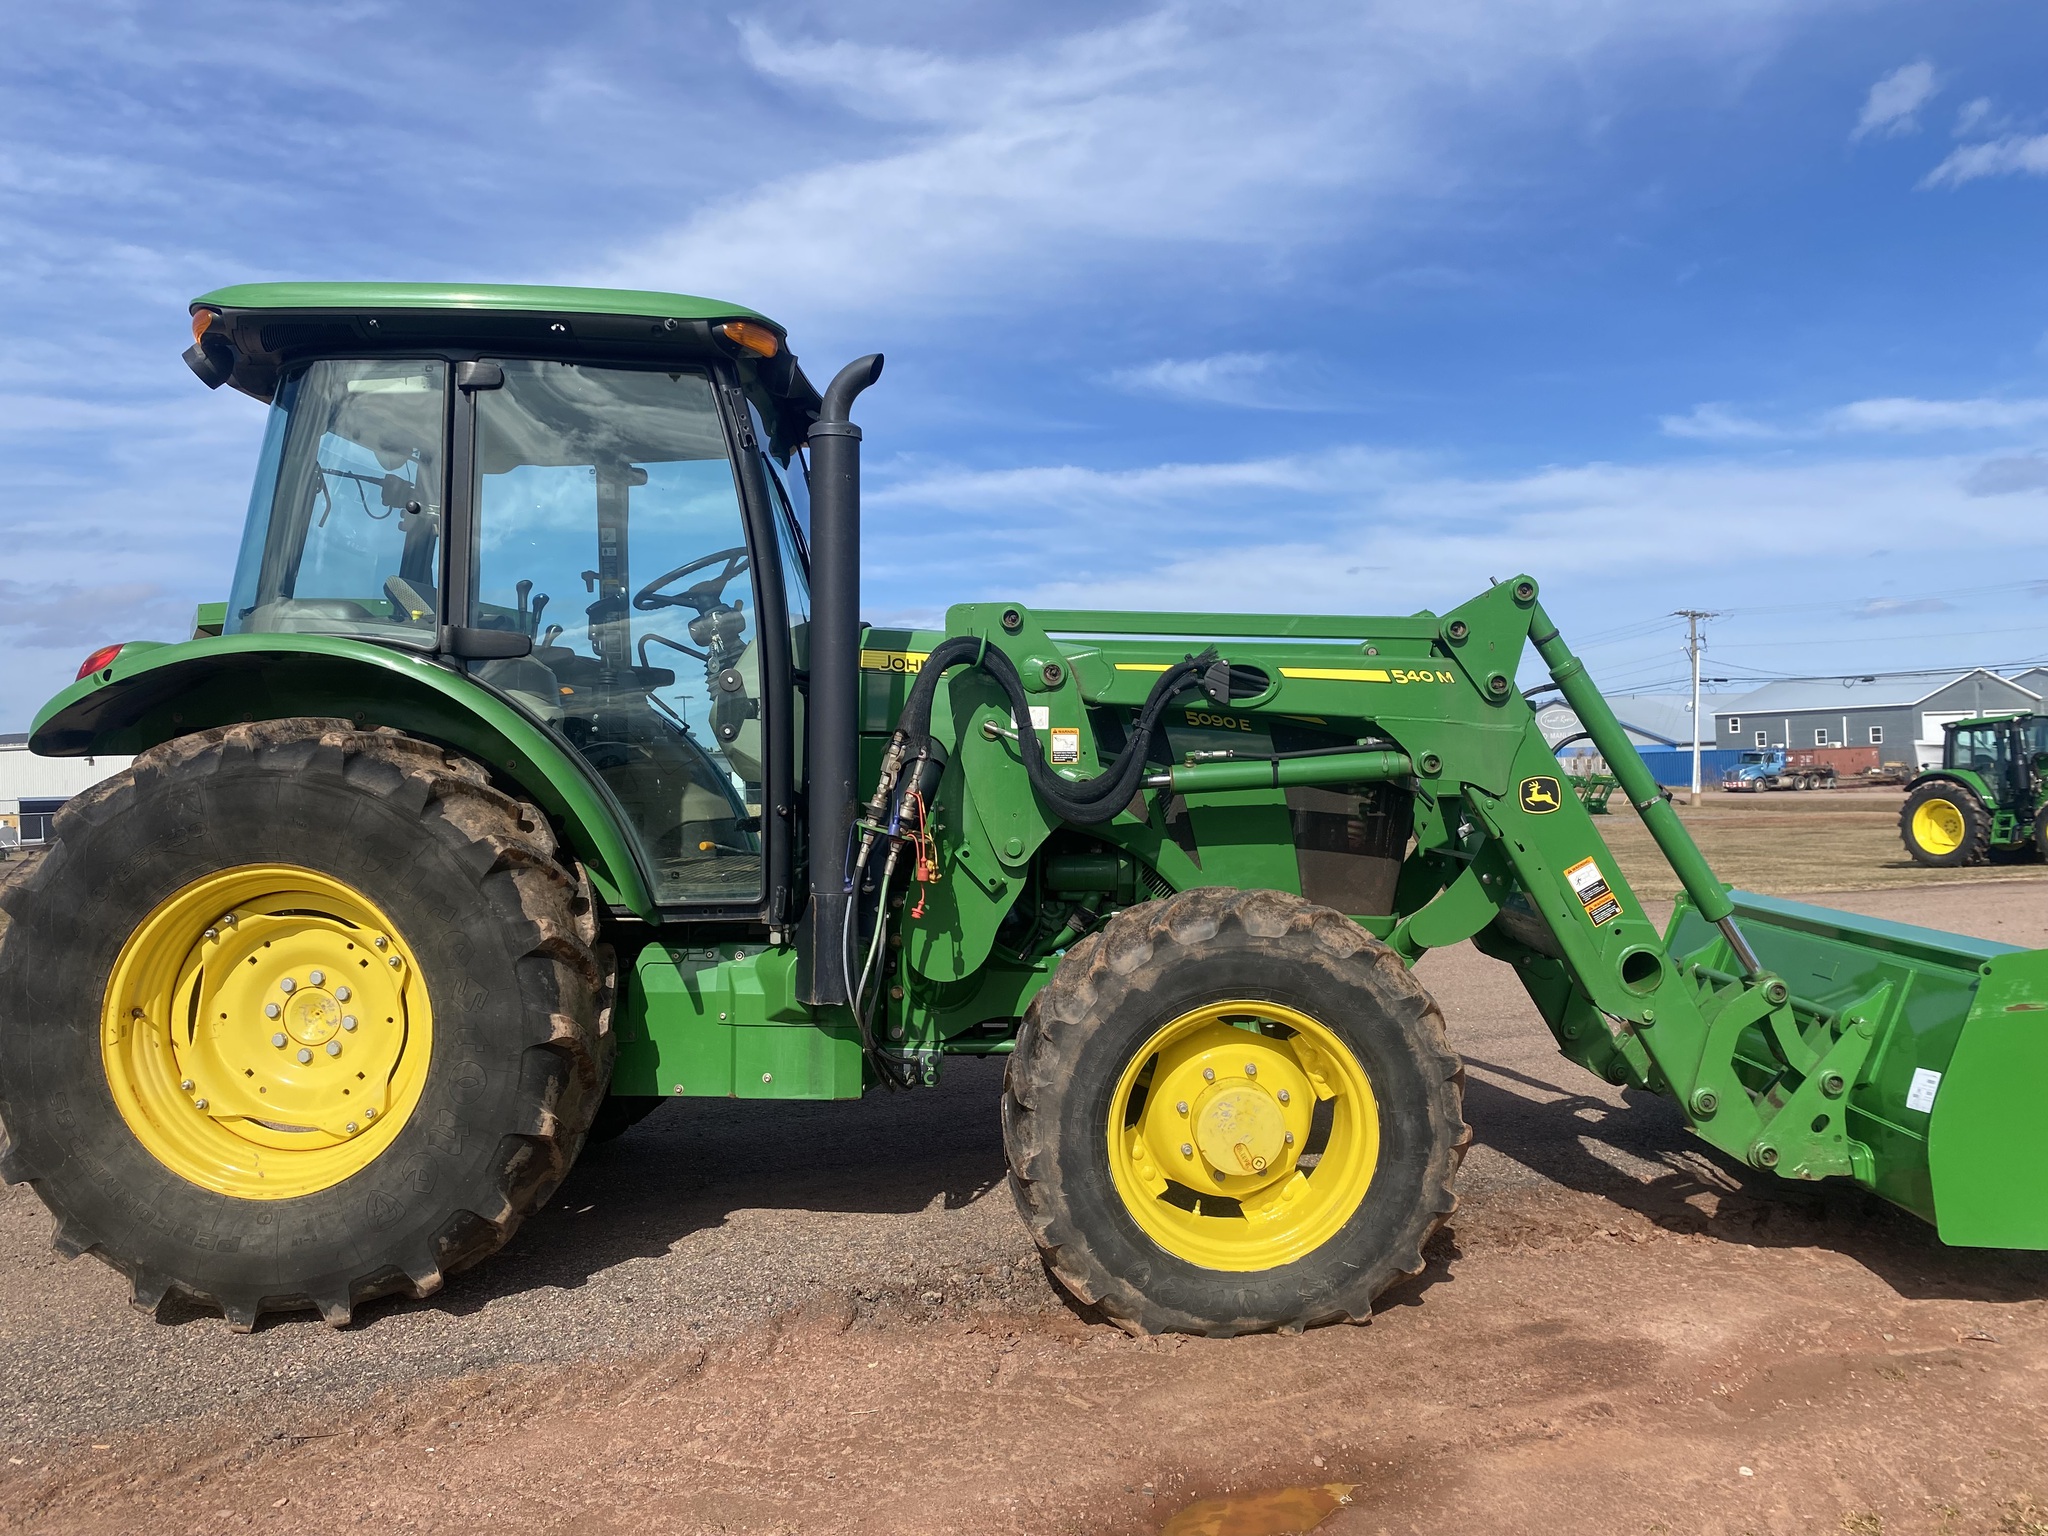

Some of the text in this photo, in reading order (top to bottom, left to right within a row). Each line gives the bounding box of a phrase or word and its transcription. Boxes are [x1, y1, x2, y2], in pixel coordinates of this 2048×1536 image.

[1390, 669, 1456, 684] 540 M
[1185, 711, 1252, 732] 5090 E
